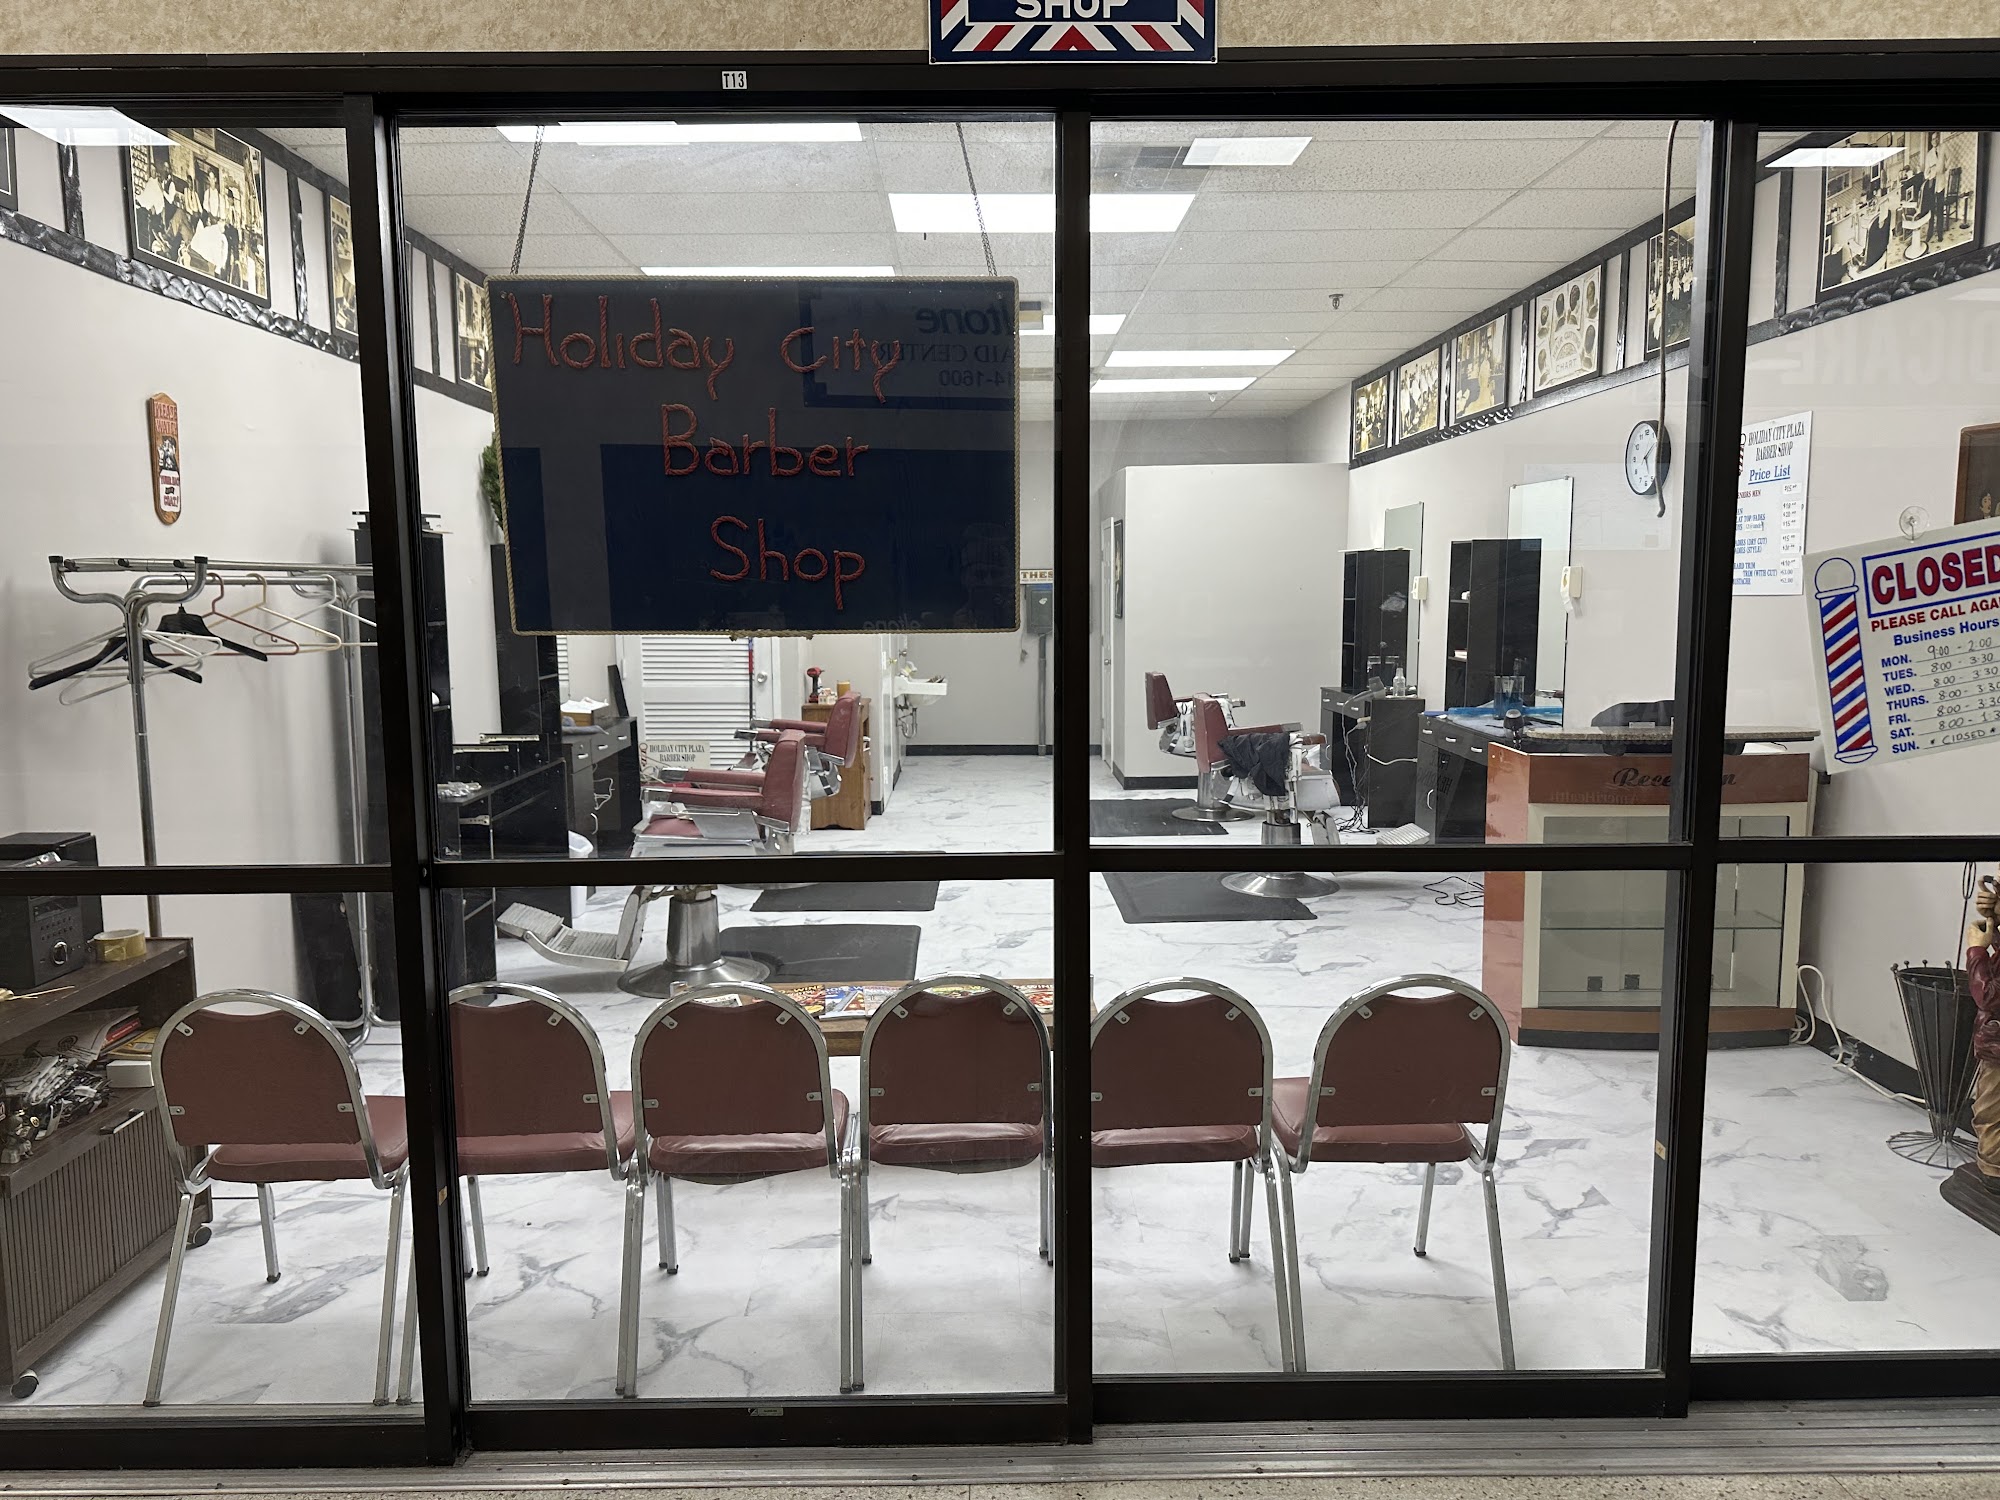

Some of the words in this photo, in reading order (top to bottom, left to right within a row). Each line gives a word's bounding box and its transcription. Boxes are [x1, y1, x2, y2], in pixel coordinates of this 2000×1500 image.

[1015, 0, 1128, 18] SHOP
[723, 72, 746, 89] T13
[508, 293, 735, 400] Holiday
[781, 328, 901, 403] City
[661, 403, 869, 477] Barber
[1748, 428, 1773, 446] HOLIDAY
[1773, 425, 1787, 441] CITY
[1786, 421, 1805, 438] PLAZA
[1756, 444, 1777, 461] BARBER
[1778, 441, 1793, 457] SHOP
[1749, 468, 1771, 481] Price
[1774, 464, 1791, 477] List
[709, 515, 866, 610] Shop
[1871, 543, 2000, 606] CLOSED
[1871, 611, 1926, 632] PLEASE
[1930, 604, 1966, 620] CALL
[1970, 597, 2000, 613] AGA
[1893, 626, 1956, 646] Business
[1959, 618, 2000, 633] Hours
[1881, 654, 1912, 668] MON.
[1883, 668, 1917, 682] TUES.
[1884, 683, 1915, 697] WED.
[1886, 695, 1930, 711] THURS.
[1888, 713, 1911, 725] FRI.
[1890, 727, 1915, 740] SAT.
[650, 744, 674, 753] HOLIDAY
[674, 744, 688, 753] CITY
[688, 744, 705, 753] PLAZA
[1892, 741, 1920, 754] SUN.
[660, 754, 680, 762] BARBER
[682, 754, 696, 762] SHOP
